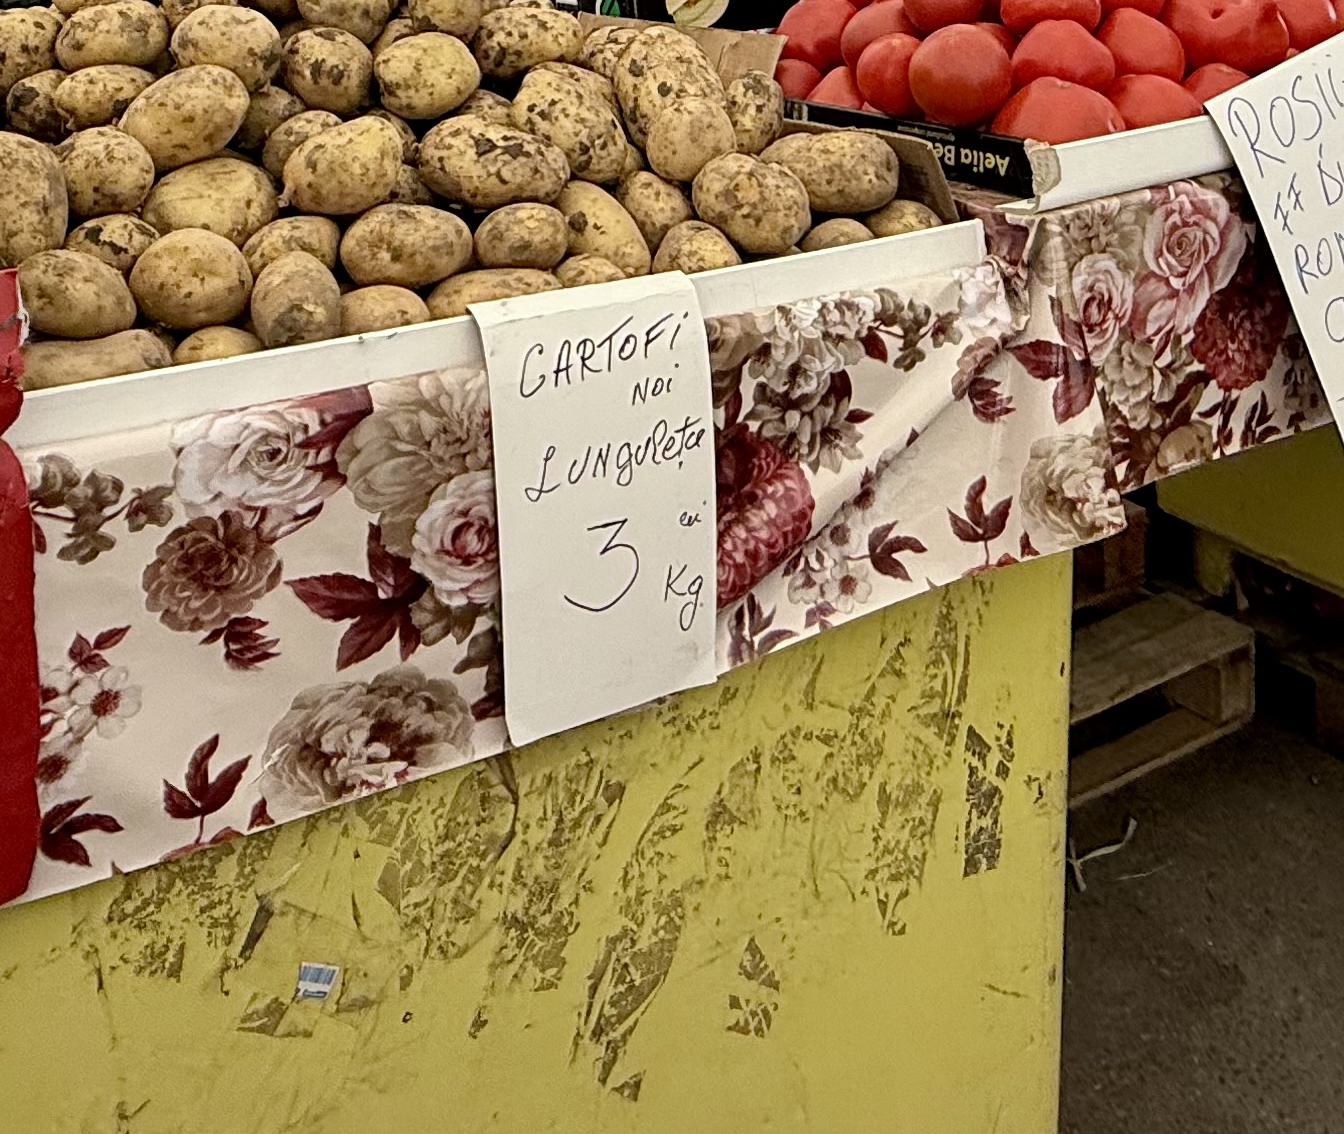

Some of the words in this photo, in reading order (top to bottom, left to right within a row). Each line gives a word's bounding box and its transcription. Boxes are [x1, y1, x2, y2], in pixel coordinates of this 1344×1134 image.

[930, 142, 956, 166] Be
[960, 147, 1010, 177] Aelia
[564, 519, 639, 613] 3
